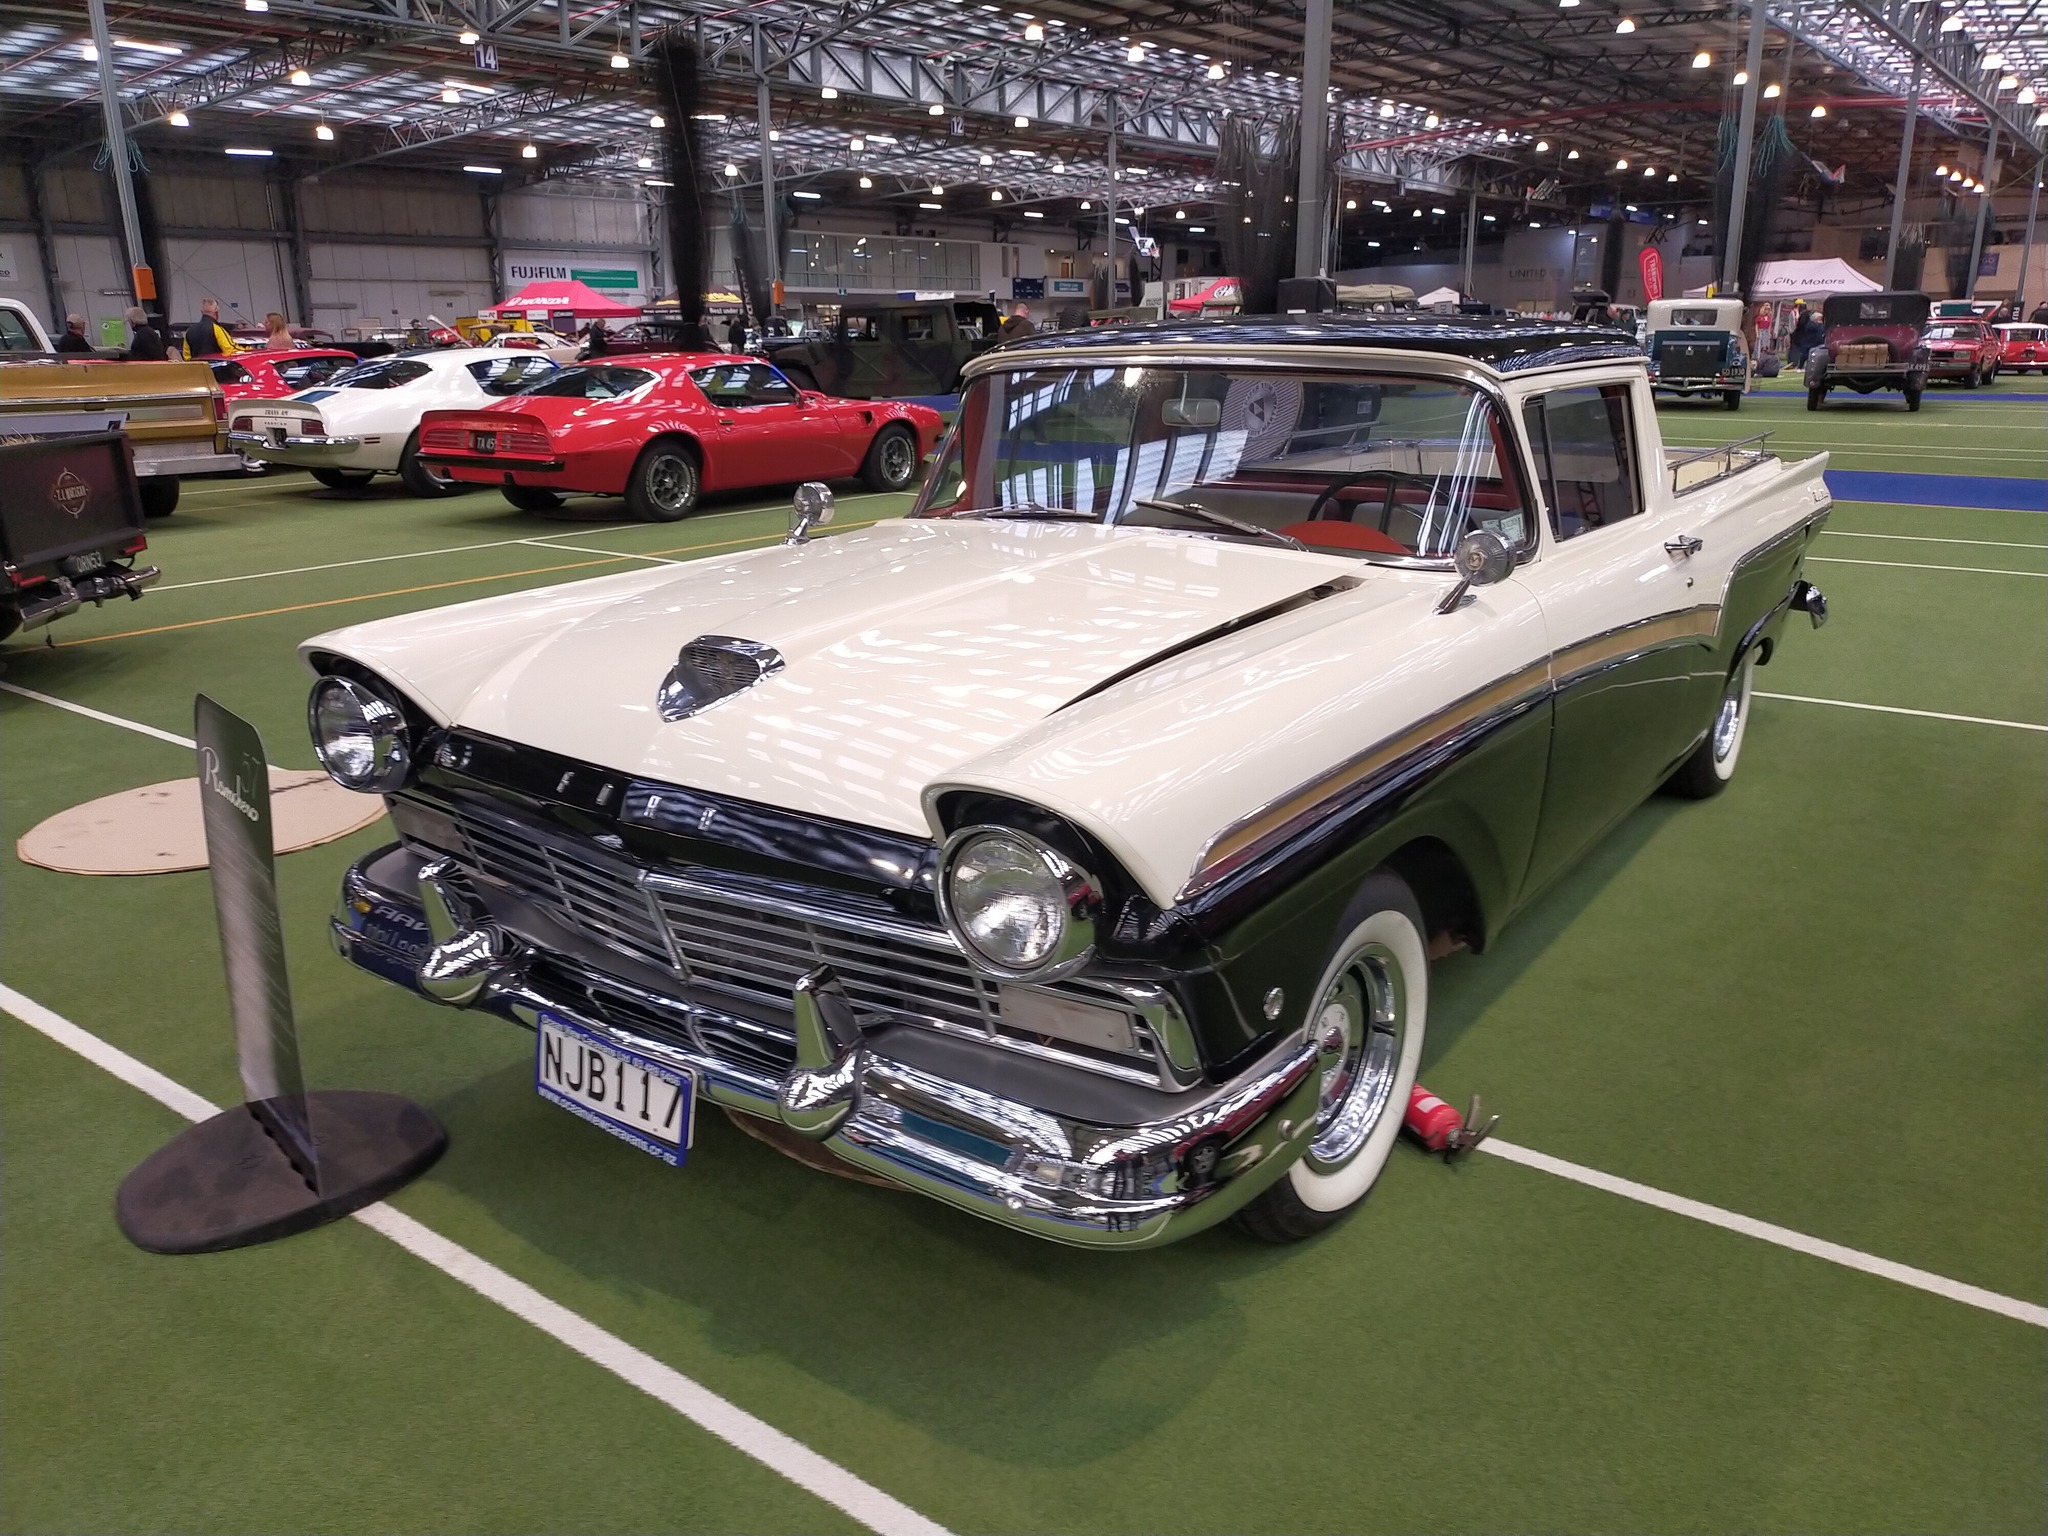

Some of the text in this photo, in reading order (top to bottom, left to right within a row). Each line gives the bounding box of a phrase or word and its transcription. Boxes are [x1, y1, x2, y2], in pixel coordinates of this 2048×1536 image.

[477, 44, 495, 69] 14
[952, 116, 963, 133] 12
[511, 265, 566, 279] FUJIFILM
[1773, 276, 1797, 286] City
[1801, 277, 1845, 286] Motors
[518, 296, 570, 306] HONDA
[476, 437, 486, 449] TA
[201, 746, 260, 822] Ranchero
[556, 771, 717, 831] FORD
[545, 1031, 682, 1129] NJB117
